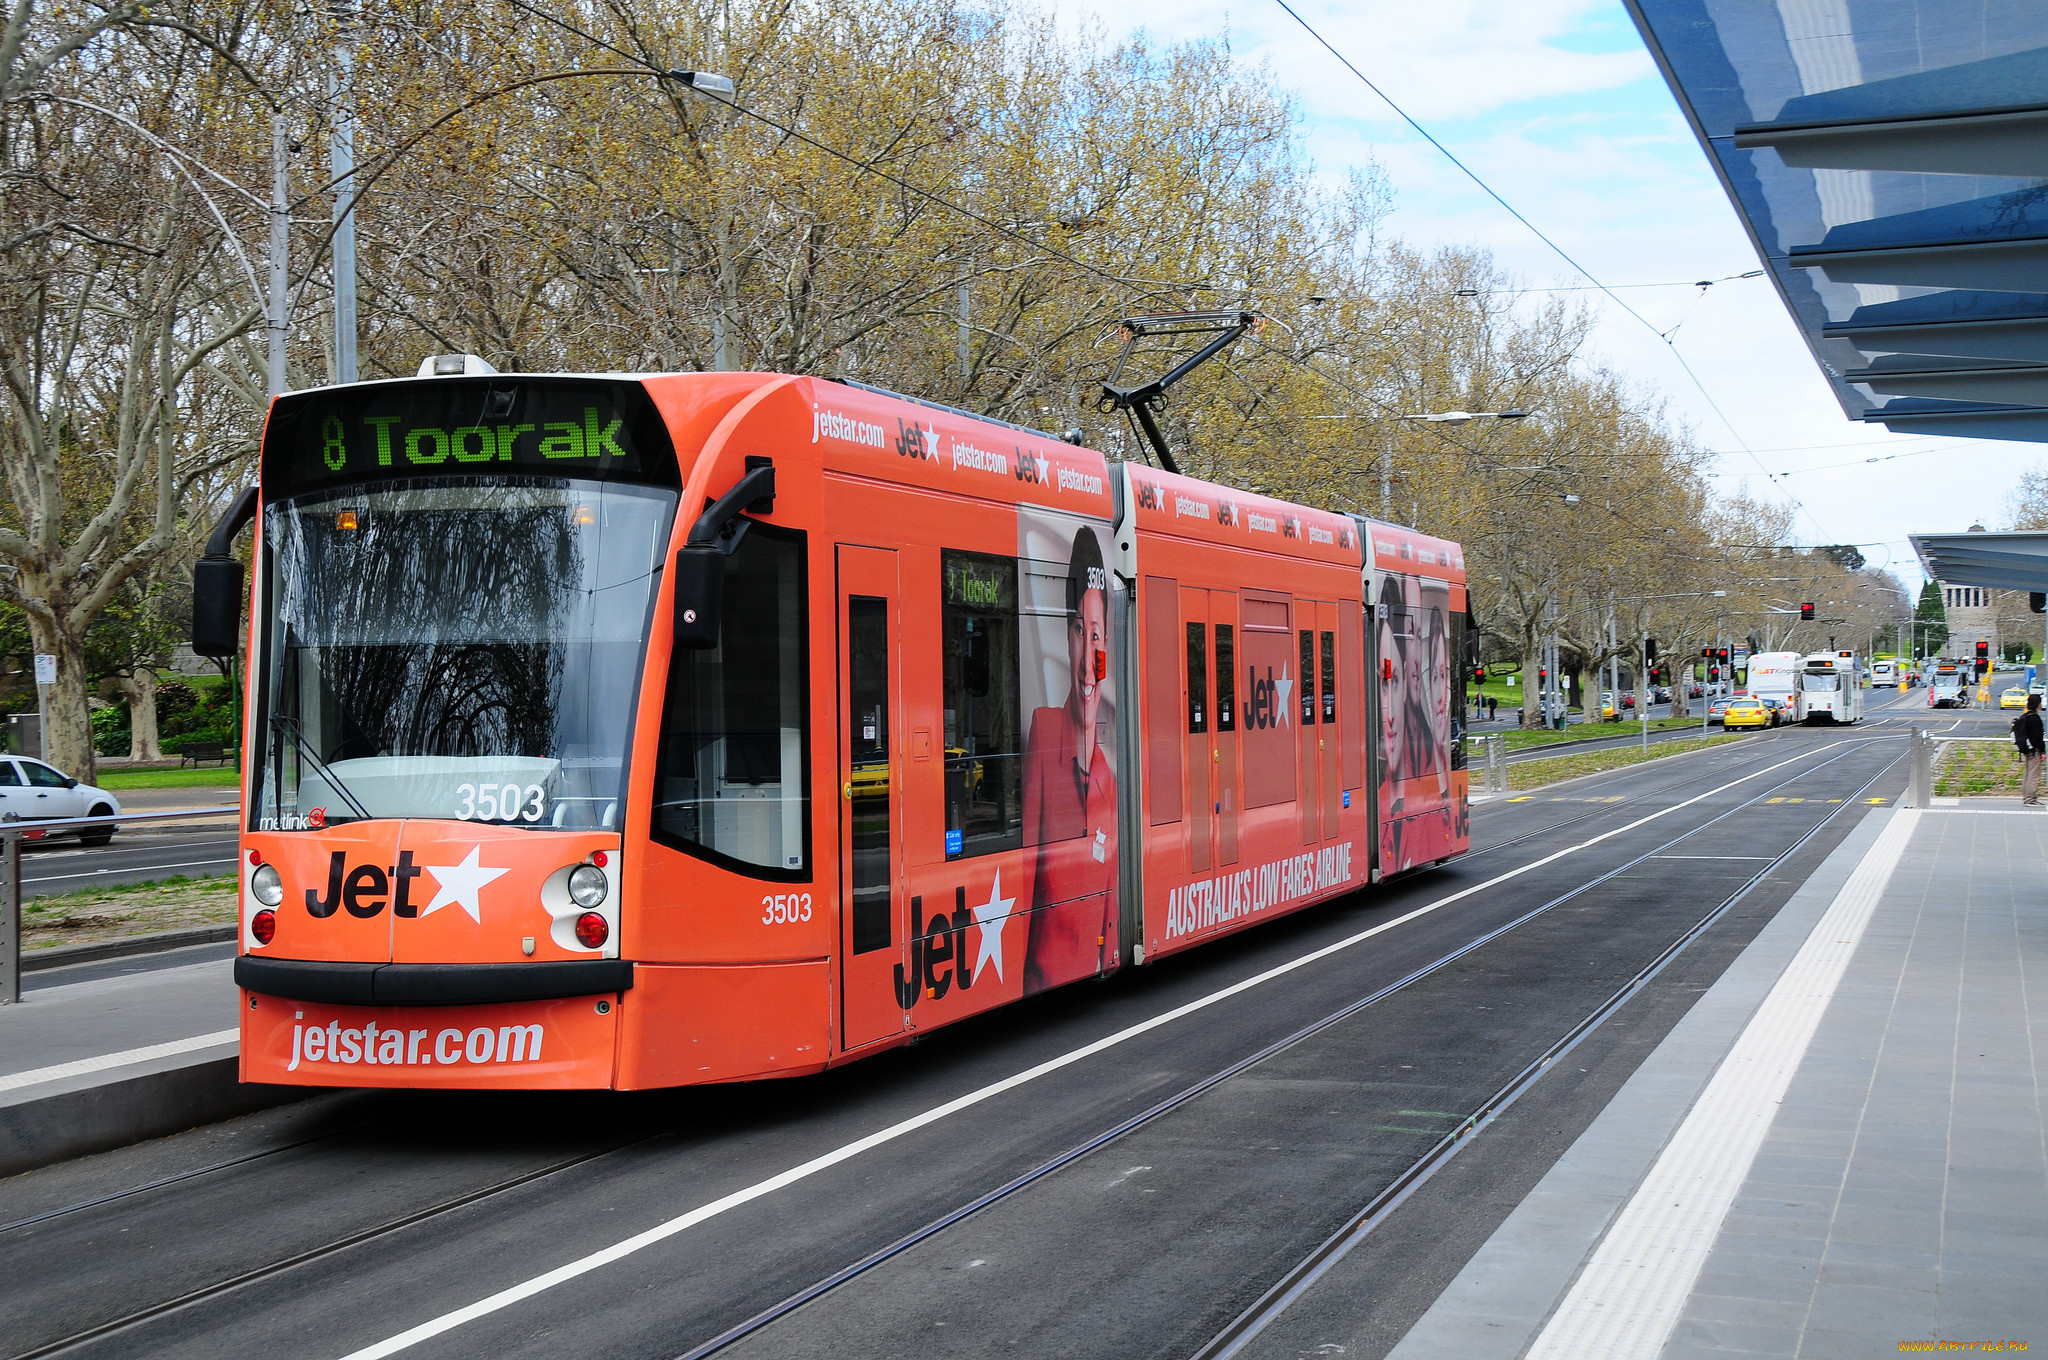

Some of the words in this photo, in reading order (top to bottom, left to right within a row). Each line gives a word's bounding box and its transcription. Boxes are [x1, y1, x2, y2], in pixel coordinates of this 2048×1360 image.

[322, 414, 347, 471] 8
[363, 405, 627, 467] Toorak
[812, 403, 885, 449] jetstar.com
[895, 417, 928, 461] Jet
[951, 436, 1008, 475] jetstar.com
[1014, 446, 1040, 485] Jet
[1056, 461, 1103, 496] jetstar.com
[1138, 478, 1158, 511] Jet
[962, 569, 999, 604] Toorak
[1087, 566, 1105, 591] 3503
[1243, 665, 1277, 730] Jet
[454, 783, 545, 822] 3503
[305, 850, 422, 919] Jet
[761, 892, 813, 925] 3503
[1166, 871, 1252, 940] AUSTRALIA'S
[1252, 860, 1281, 912] LOW
[1281, 851, 1314, 902] FARES
[1314, 841, 1352, 891] AIRLINE
[893, 886, 973, 1010] Jet
[287, 1011, 545, 1072] jetstar.com
